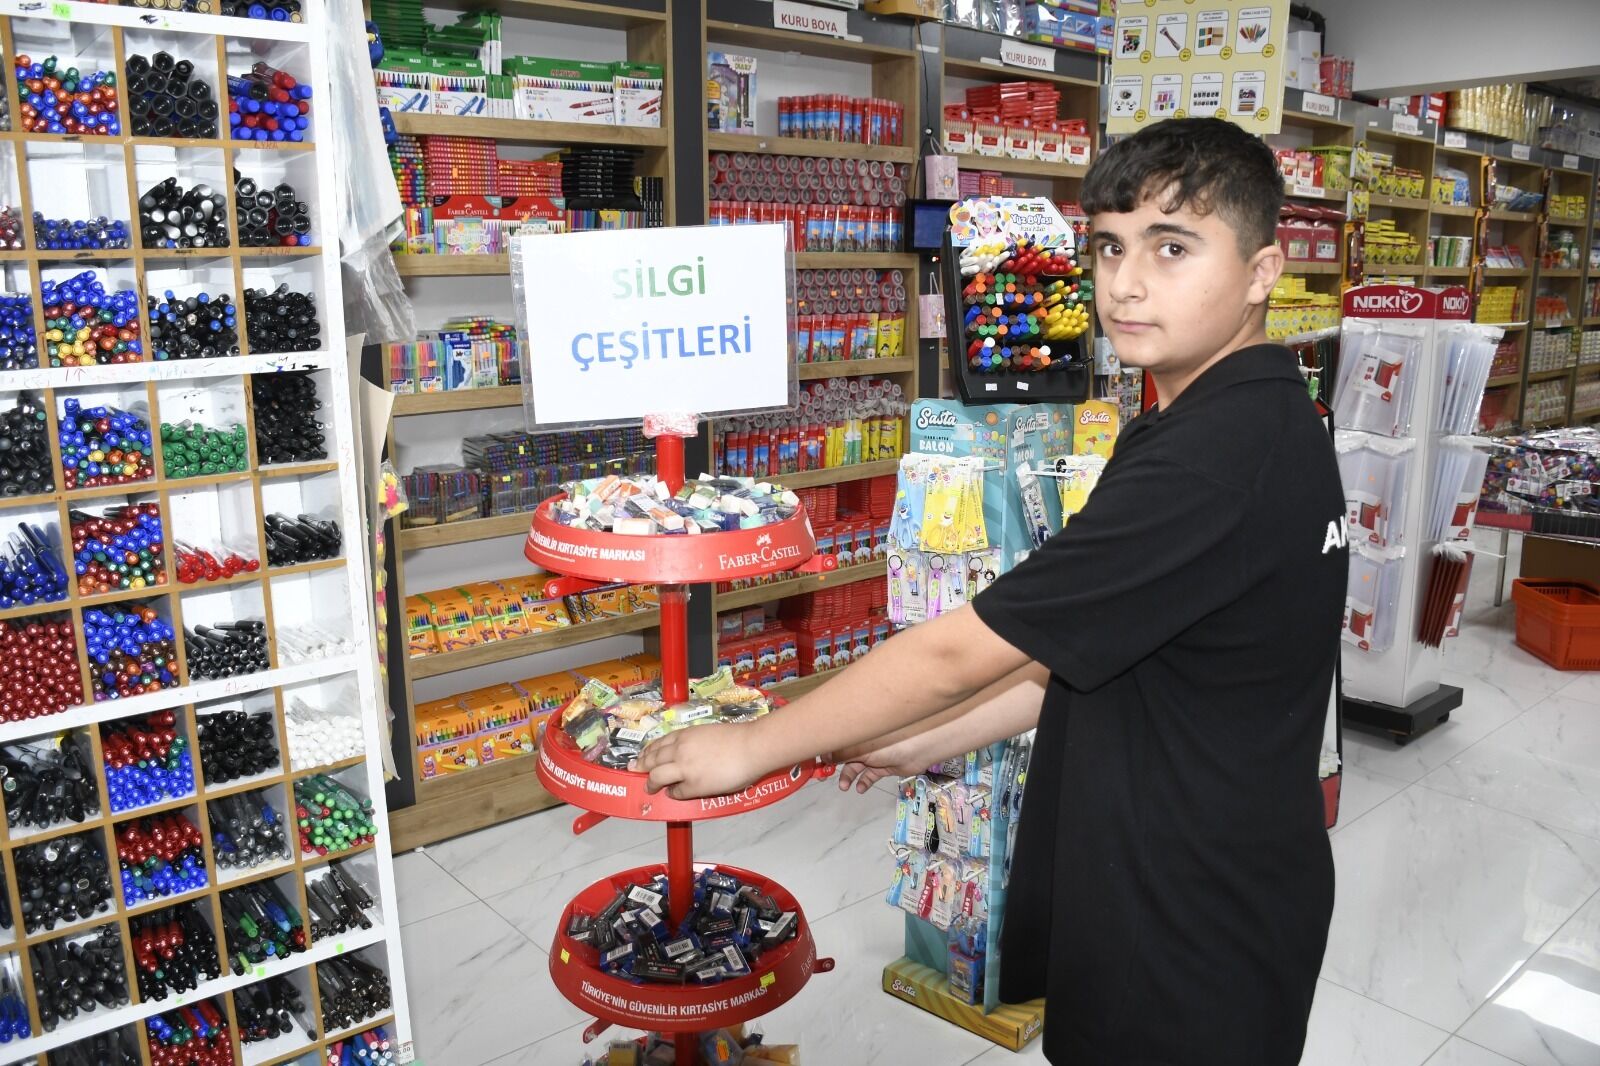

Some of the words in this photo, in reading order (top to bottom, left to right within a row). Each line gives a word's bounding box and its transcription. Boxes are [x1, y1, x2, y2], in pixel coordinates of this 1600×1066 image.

[781, 13, 809, 29] KURU
[811, 18, 838, 33] BOYA
[1005, 51, 1026, 64] KURU
[1027, 55, 1047, 67] BOYA
[612, 255, 706, 300] SİLGİ
[571, 315, 752, 372] ÇEŞİTLERİ
[916, 407, 958, 430] Sasta
[1080, 409, 1111, 425] Sasta
[919, 440, 954, 453] BALON
[556, 541, 599, 559] KIRTASİYE
[599, 547, 646, 561] MARKASI
[719, 545, 801, 570] FABER-CASTELL
[554, 765, 587, 789] KIRTASİYE
[586, 780, 627, 798] MARKASI
[701, 778, 790, 811] FABER-CASTELL
[581, 980, 627, 1010] TÜRKİYE'NİN
[629, 1000, 678, 1016] GÜVENİLİR
[680, 999, 729, 1016] KIRTASİYE
[730, 986, 768, 1008] MARKASI
[892, 979, 917, 998] Sasta
